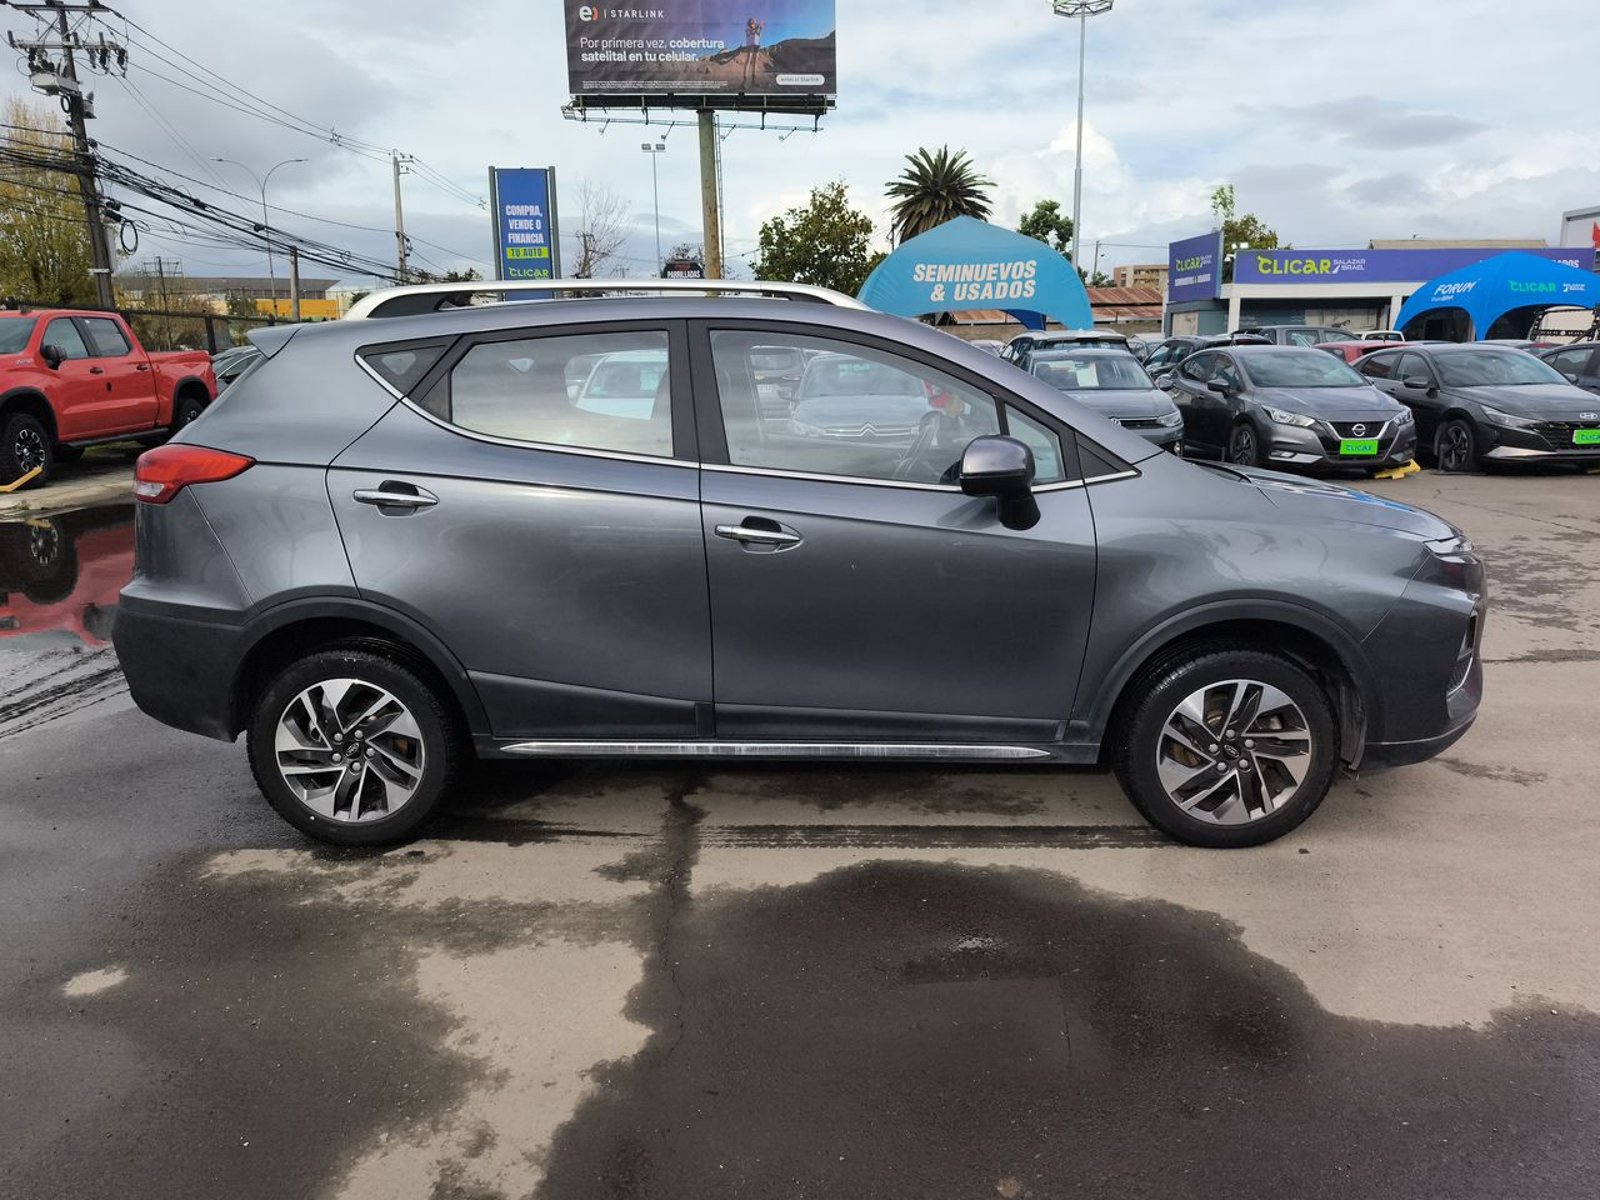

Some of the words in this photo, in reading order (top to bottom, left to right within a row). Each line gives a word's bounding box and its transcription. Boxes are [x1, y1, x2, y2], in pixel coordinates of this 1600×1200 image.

[610, 10, 665, 18] STARLINK
[580, 38, 599, 49] Por
[602, 39, 644, 50] primera
[646, 40, 668, 49] vez,
[669, 38, 725, 49] cobertura
[581, 51, 627, 62] satelital
[629, 53, 643, 62] en
[644, 52, 657, 62] tu
[658, 51, 700, 62] celular.
[505, 205, 543, 217] COMPRA,
[508, 219, 533, 230] VENDE
[535, 219, 542, 230] O
[508, 233, 544, 243] FINANCIA
[511, 248, 521, 257] TU
[523, 248, 542, 258] AUTO
[1175, 256, 1201, 272] CLICAR
[1257, 255, 1331, 275] CLICAR
[508, 267, 549, 278] CLICAR
[913, 260, 1037, 282] SEMINUEVOS
[930, 283, 945, 302] &
[953, 279, 1036, 301] USADOS
[1434, 281, 1477, 295] FORUM
[1508, 280, 1556, 292] CLICAR
